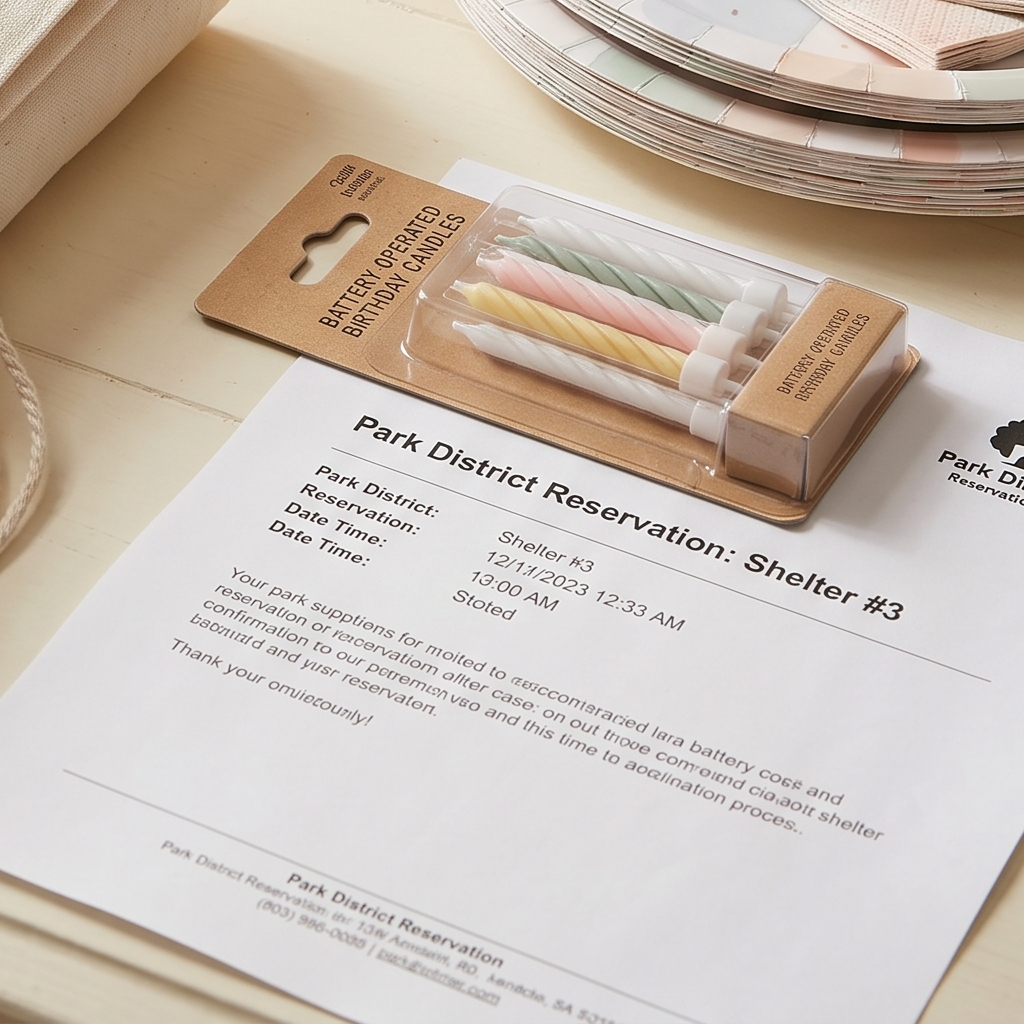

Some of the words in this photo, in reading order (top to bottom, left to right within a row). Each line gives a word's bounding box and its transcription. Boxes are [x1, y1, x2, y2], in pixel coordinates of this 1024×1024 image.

[318, 268, 381, 329] BATTERY
[373, 205, 441, 269] OPERATED
[341, 272, 410, 338] BIRTHDAY
[402, 213, 466, 273] CANDLES
[314, 464, 360, 490] Park
[362, 482, 439, 518] District:
[937, 449, 994, 479] Park
[997, 470, 1024, 491] Di
[284, 501, 330, 527] Date
[335, 519, 388, 549] Time:
[299, 483, 421, 536] Reservation:
[352, 414, 425, 453] Park
[426, 441, 539, 494] District
[542, 480, 737, 564] Reservation:
[743, 552, 859, 606] Shelter
[862, 594, 905, 622] #3
[268, 519, 314, 546] Date
[319, 537, 372, 567] Time:
[498, 530, 567, 563] Shelter
[523, 591, 560, 612] AM
[596, 590, 648, 618] 12:33
[648, 611, 686, 632] AM
[171, 637, 224, 669] Thank
[223, 663, 267, 685] your
[266, 645, 303, 663] and
[231, 567, 269, 590] Your
[267, 586, 309, 607] park
[397, 632, 424, 649] for
[489, 666, 507, 680] to
[689, 740, 755, 775] battery
[806, 787, 845, 806] and
[312, 641, 333, 655] to
[336, 651, 367, 666] our
[484, 707, 522, 726] and
[522, 719, 555, 740] this
[559, 733, 598, 756] time
[602, 750, 621, 765] to
[311, 622, 332, 634] or
[542, 709, 566, 724] on
[569, 719, 601, 736] out
[817, 812, 885, 842] shelter
[287, 872, 328, 899] Park
[331, 890, 396, 926] District
[397, 917, 505, 969] Reservation
